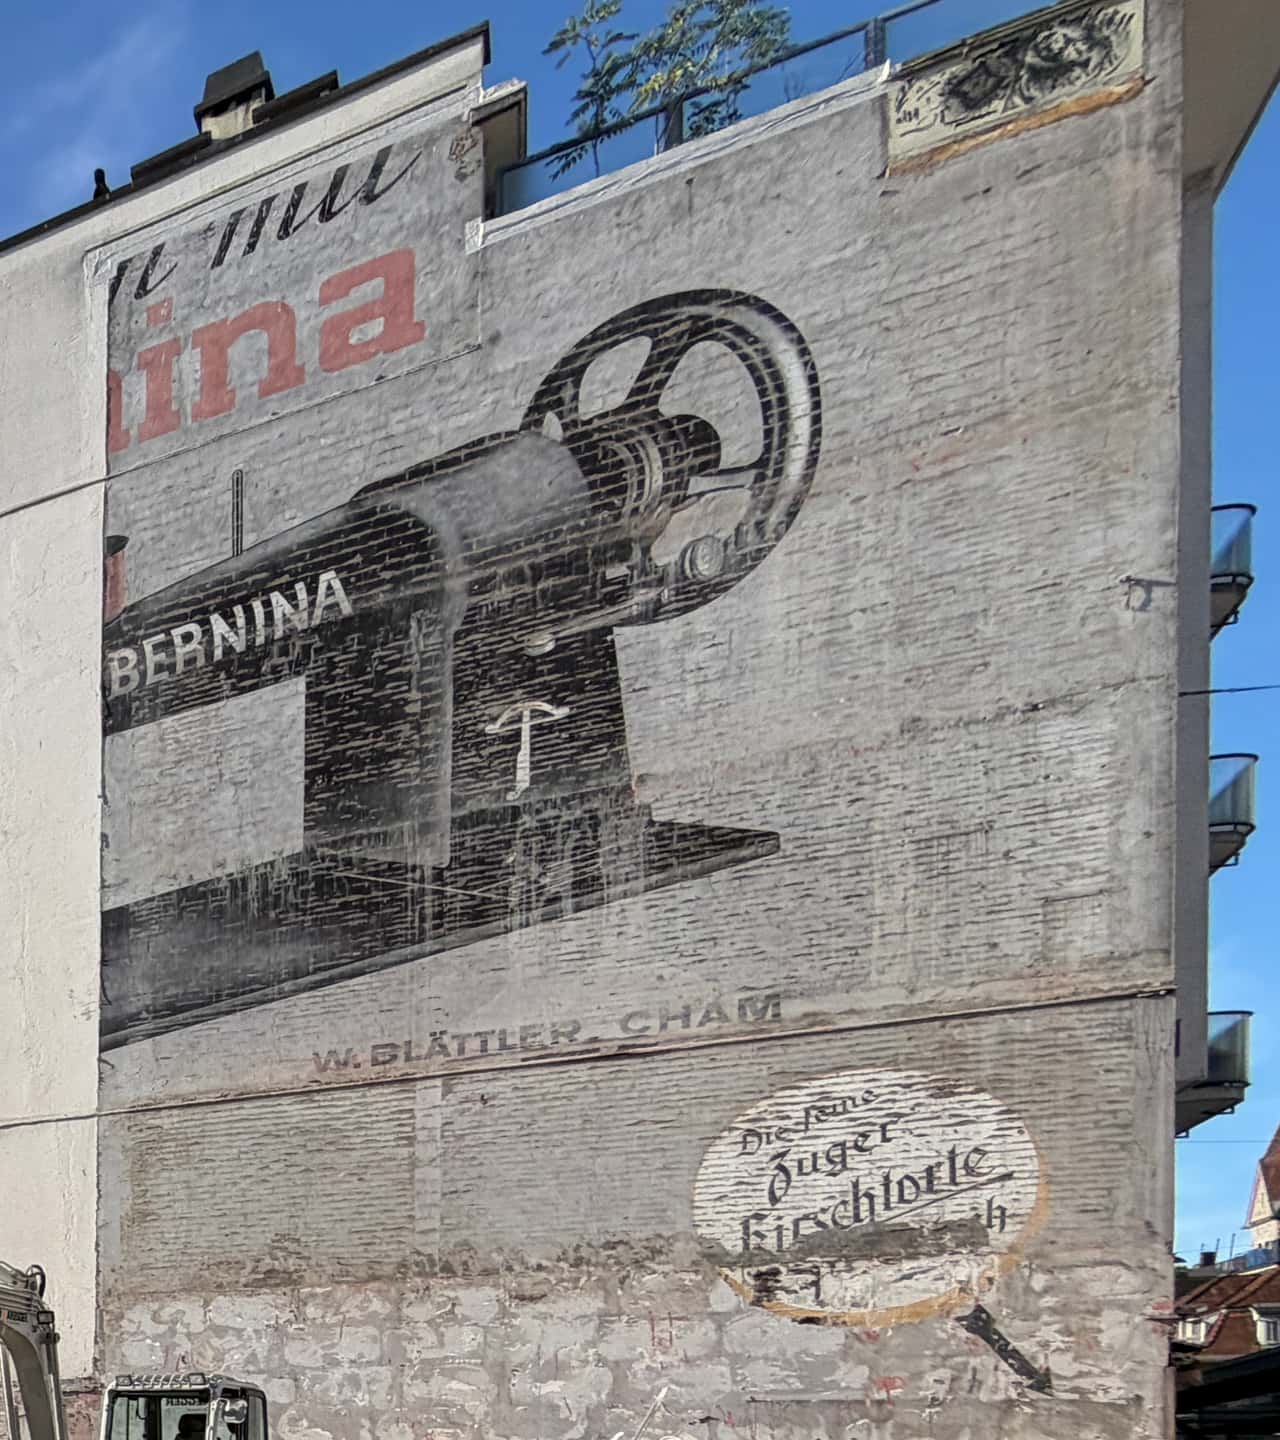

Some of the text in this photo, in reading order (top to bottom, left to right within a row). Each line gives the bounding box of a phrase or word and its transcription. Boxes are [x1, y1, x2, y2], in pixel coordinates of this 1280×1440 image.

[105, 569, 354, 698] BERNINA
[619, 993, 783, 1035] CHAM
[767, 1114, 904, 1206] Zuger
